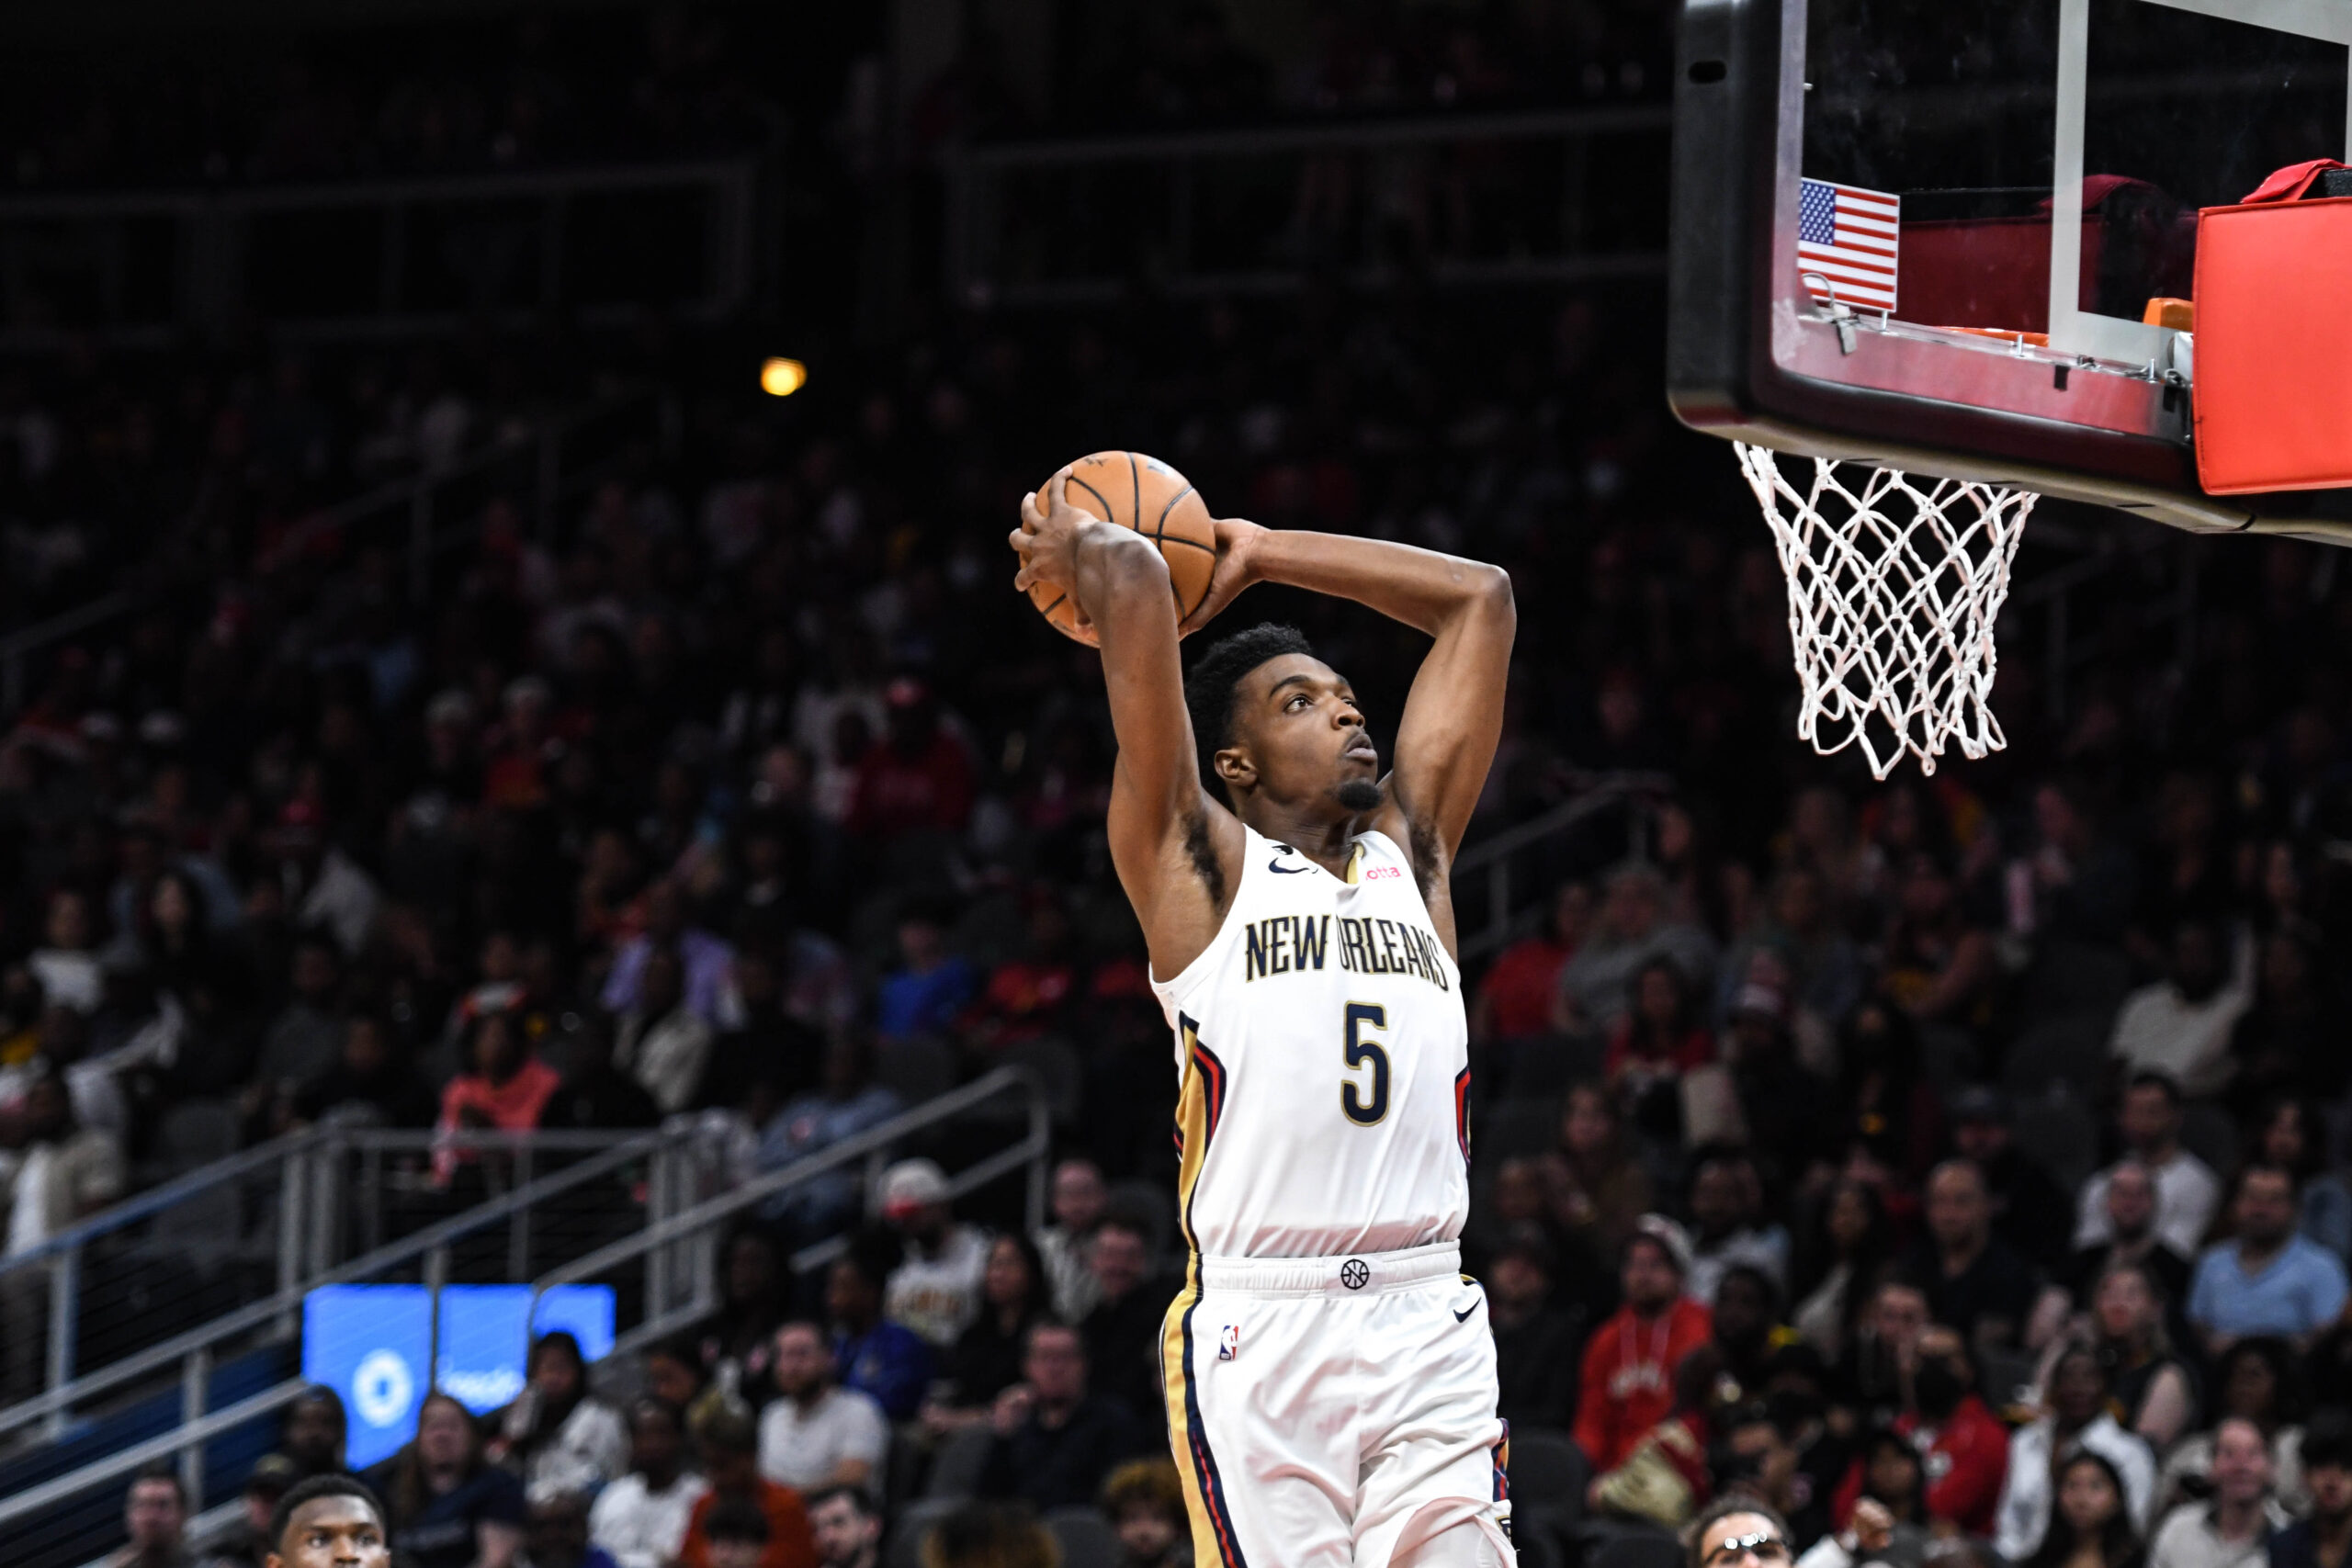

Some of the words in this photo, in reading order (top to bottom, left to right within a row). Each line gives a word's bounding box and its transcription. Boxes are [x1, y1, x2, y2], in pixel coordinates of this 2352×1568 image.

[1365, 866, 1401, 881] otta
[1245, 914, 1331, 983] NEW
[1336, 914, 1449, 992] ORLEANS
[1340, 999, 1391, 1127] 5
